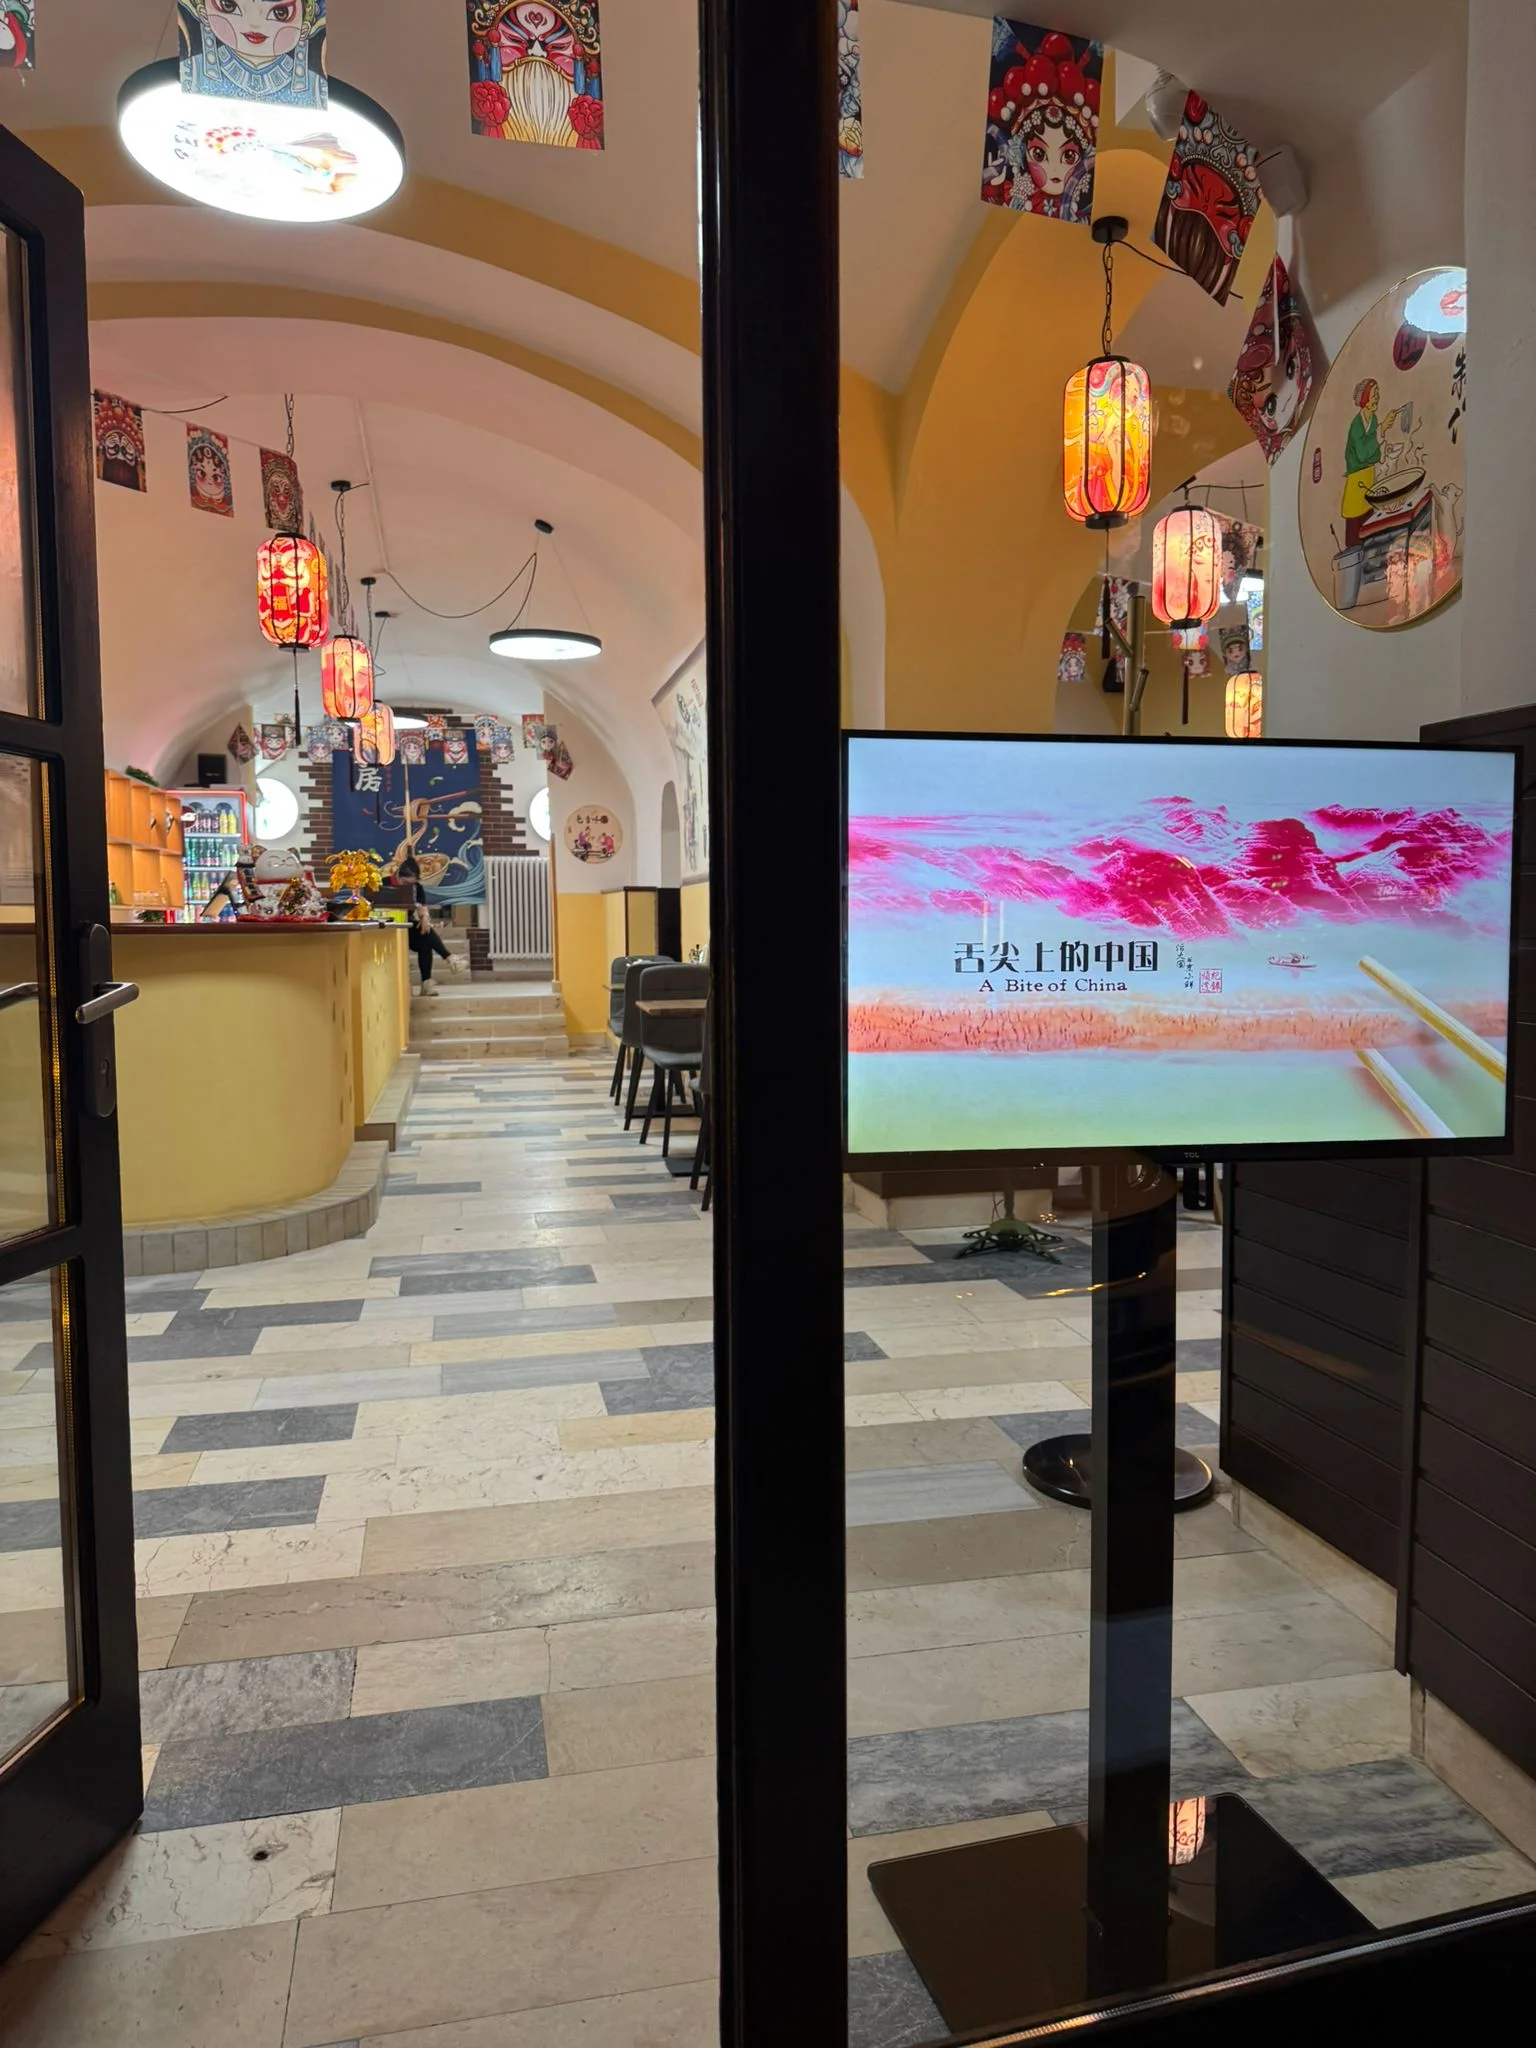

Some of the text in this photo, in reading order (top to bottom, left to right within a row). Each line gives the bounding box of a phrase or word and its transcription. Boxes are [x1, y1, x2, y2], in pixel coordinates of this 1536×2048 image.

[954, 940, 1158, 973] 舌尖上的中国
[978, 978, 1128, 992] A Bite of China
